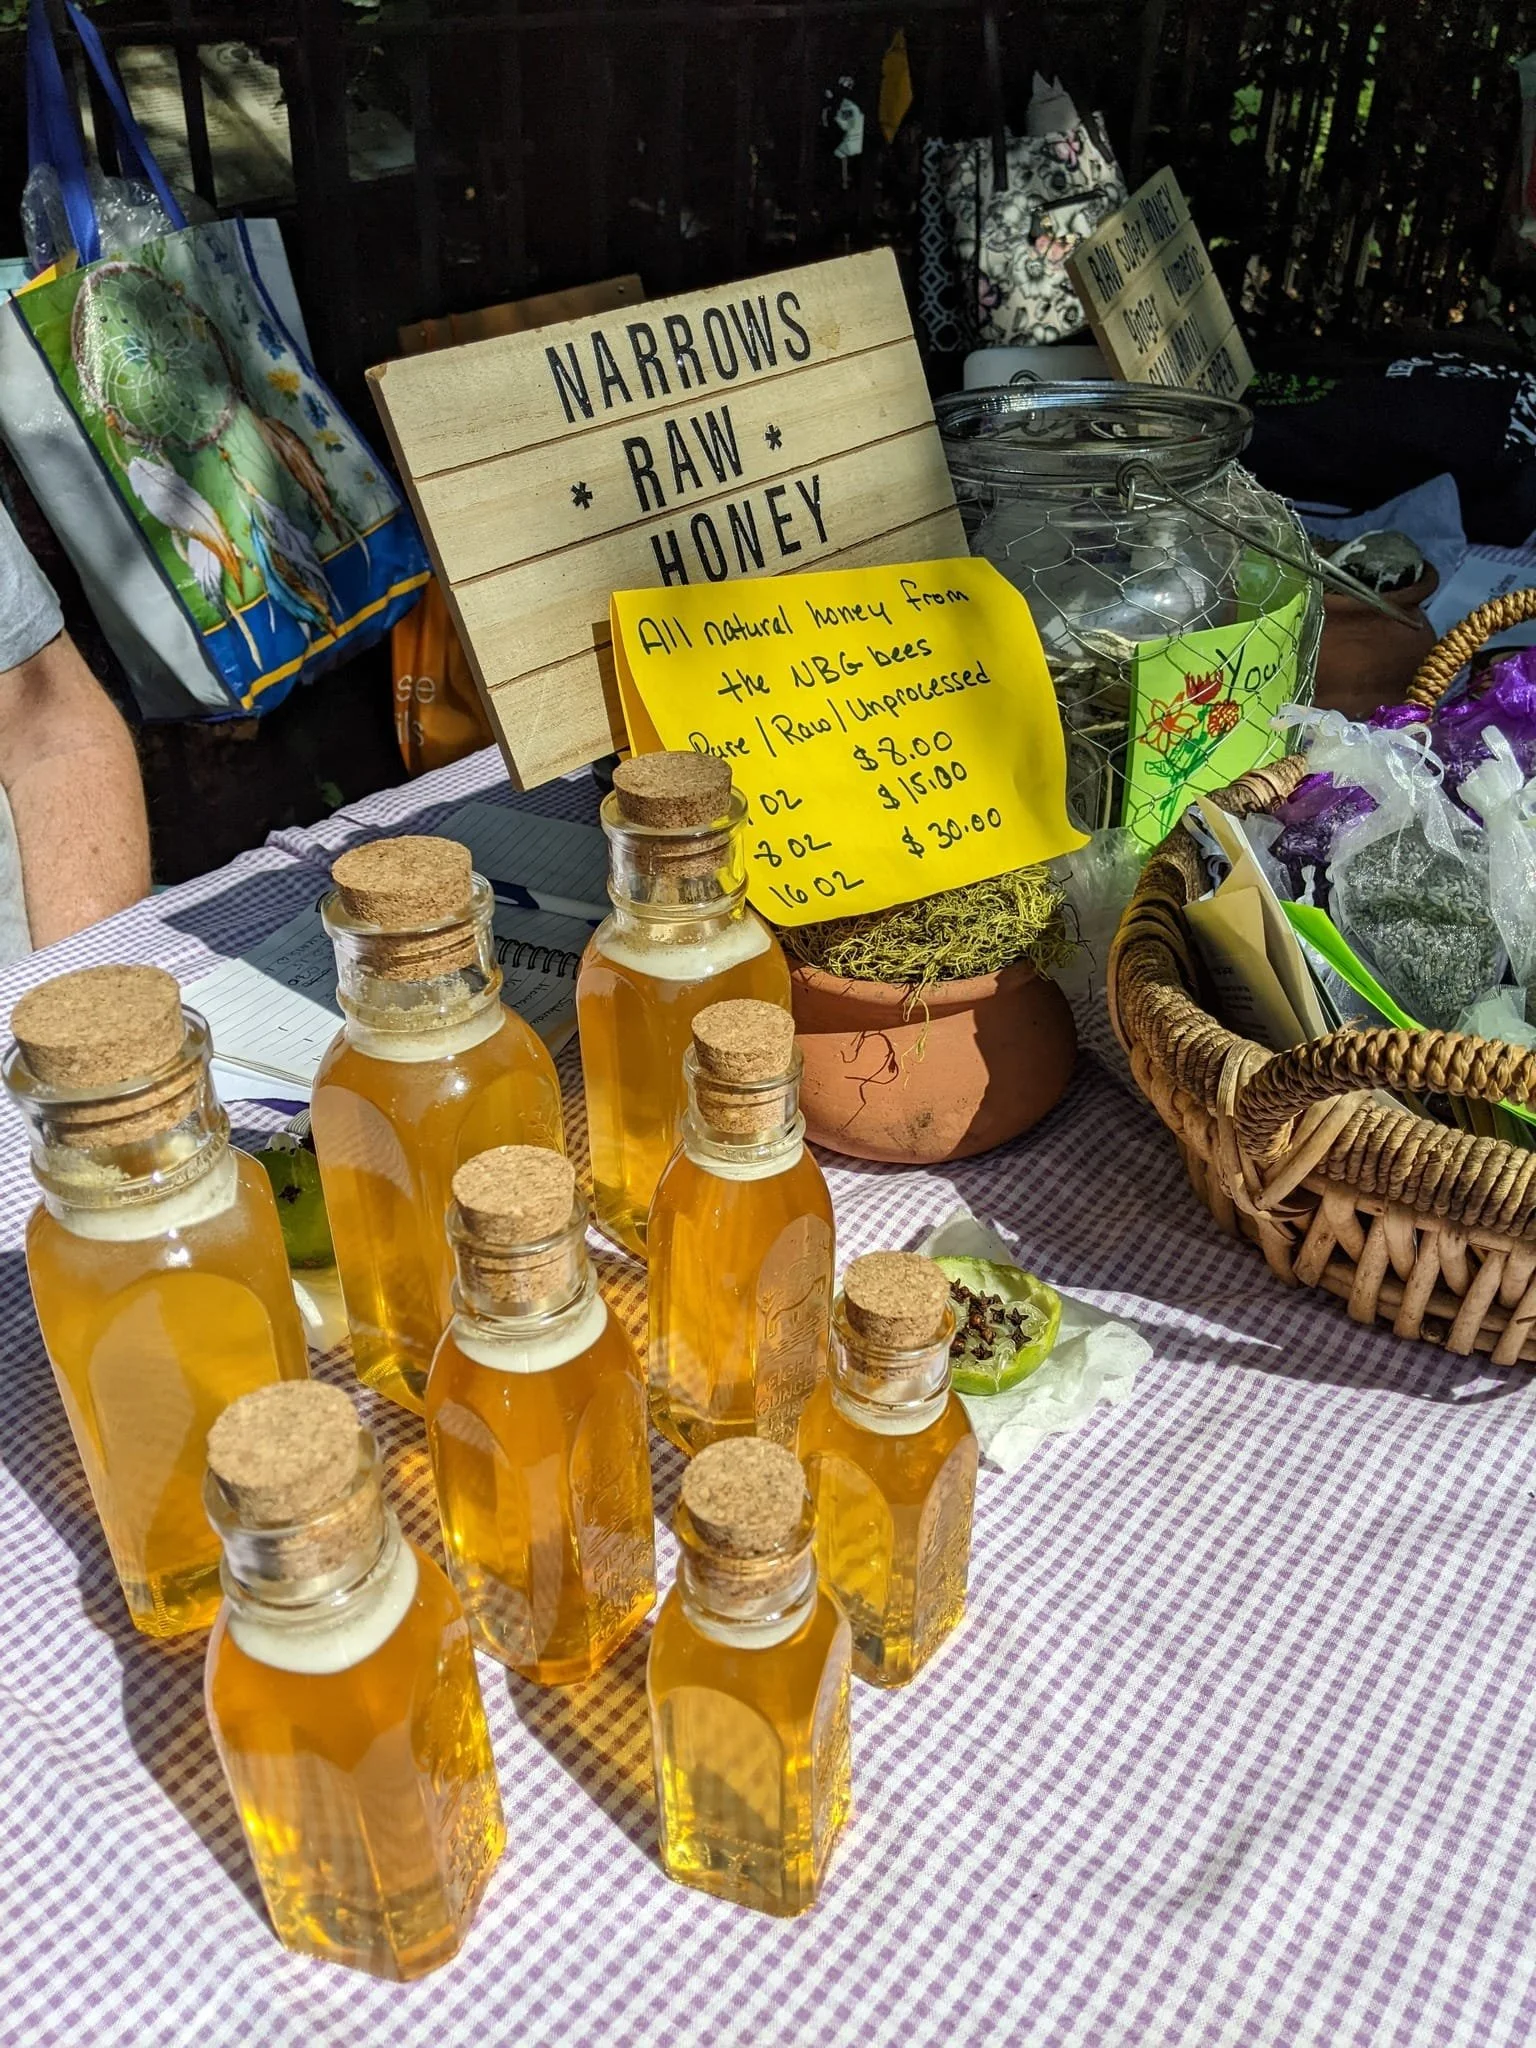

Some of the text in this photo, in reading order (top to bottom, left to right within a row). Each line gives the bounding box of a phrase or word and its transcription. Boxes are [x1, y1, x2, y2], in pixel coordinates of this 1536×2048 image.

[1087, 241, 1125, 304] RAW
[1138, 183, 1181, 244] HONEY
[545, 291, 812, 423] NARROWS
[623, 405, 743, 512] RAW
[651, 474, 828, 587] HONEY
[637, 579, 969, 655] All natural honey from
[718, 636, 932, 703] the NBG bees
[768, 883, 808, 908] 16
